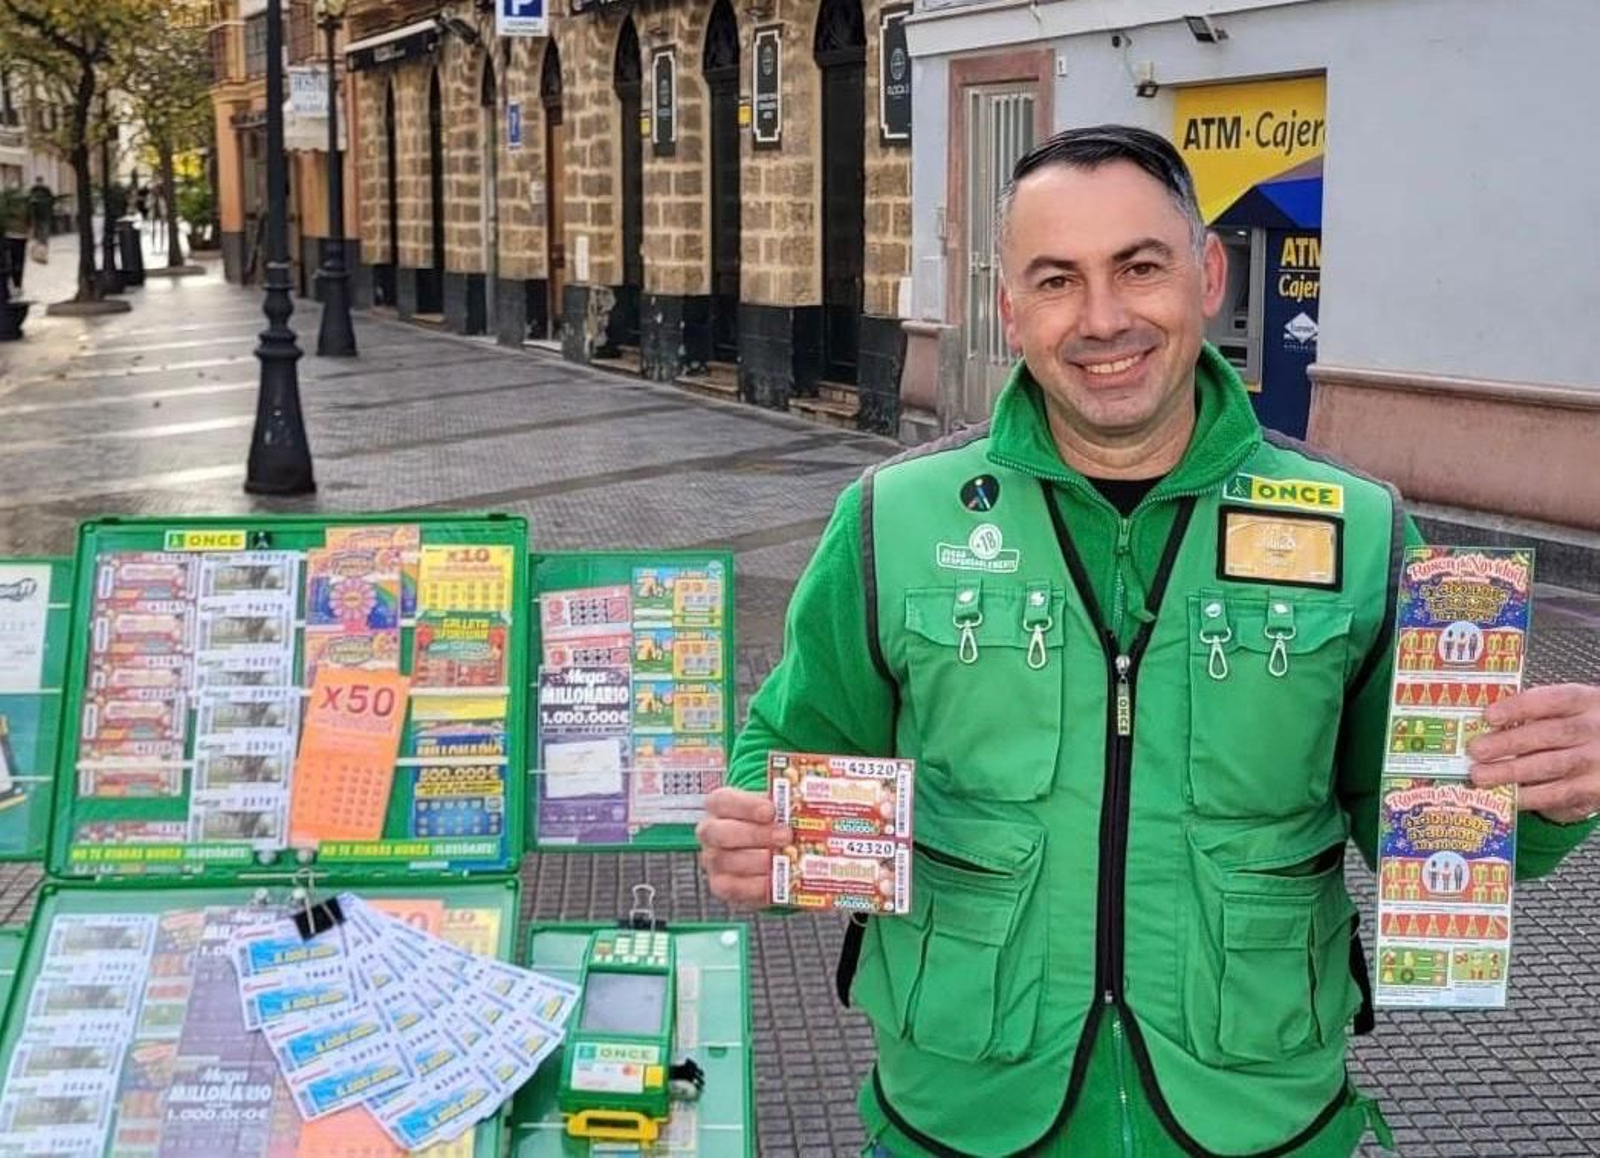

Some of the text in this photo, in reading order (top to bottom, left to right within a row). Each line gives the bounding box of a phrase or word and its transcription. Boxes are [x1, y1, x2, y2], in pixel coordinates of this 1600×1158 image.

[1255, 110, 1326, 157] Cajer
[1258, 484, 1333, 505] ONCE
[189, 534, 241, 547] ONCE
[541, 685, 629, 705] MILLONARIO
[848, 762, 895, 776] 42320
[846, 841, 893, 855] 42320
[599, 1046, 652, 1060] ONCE
